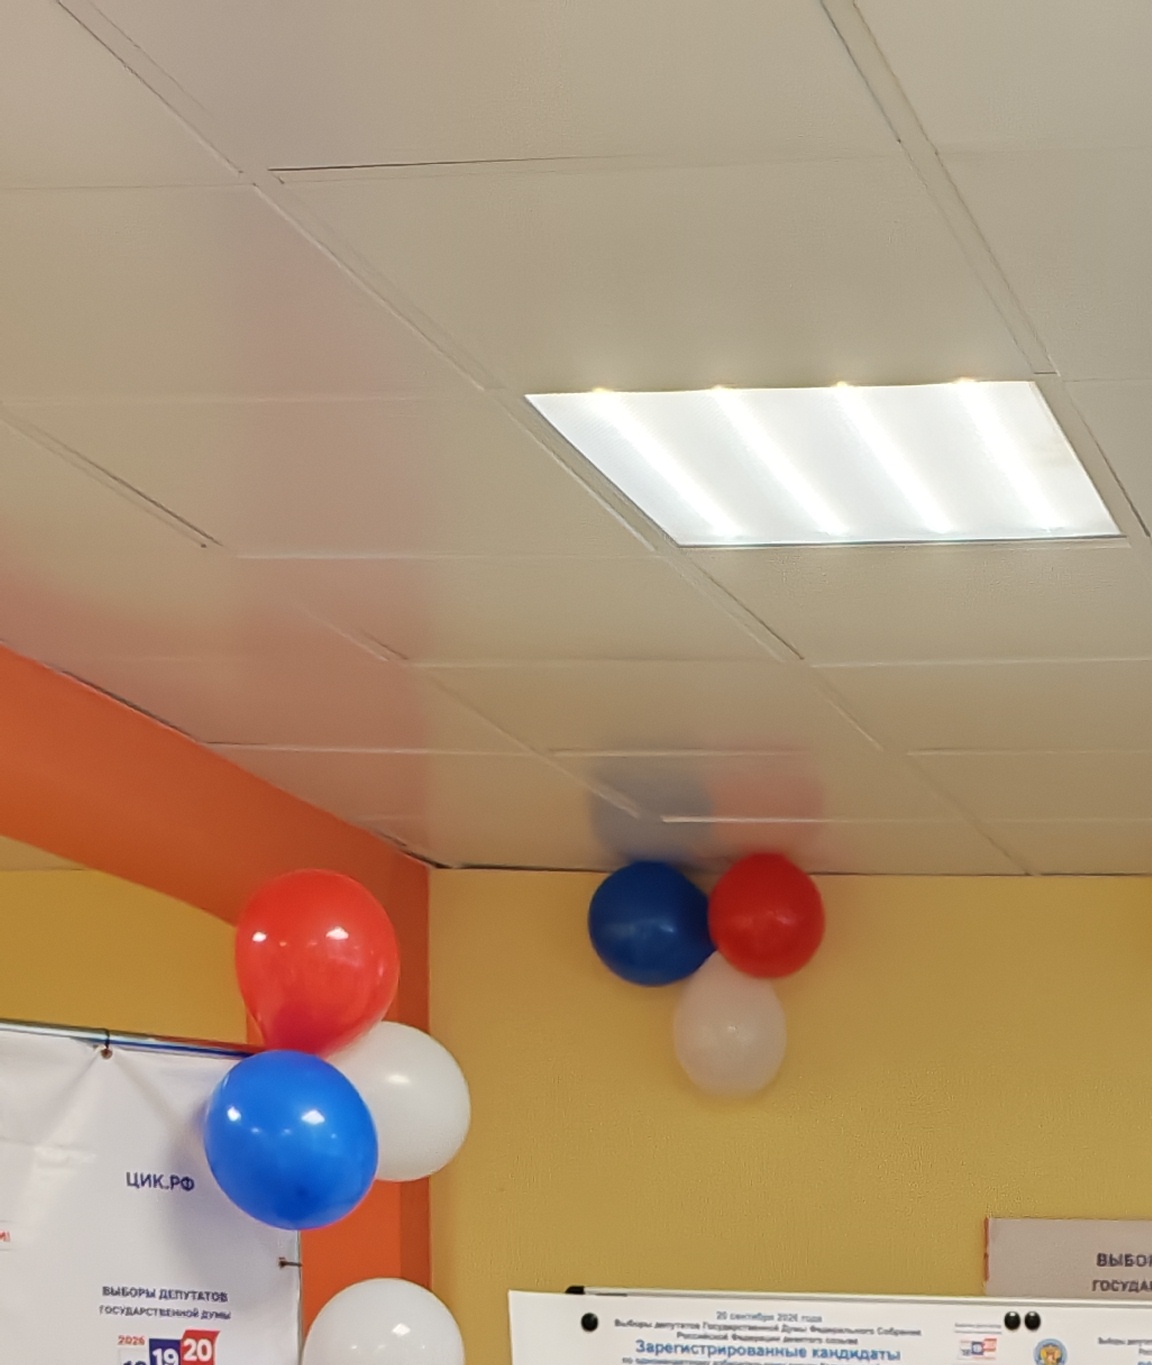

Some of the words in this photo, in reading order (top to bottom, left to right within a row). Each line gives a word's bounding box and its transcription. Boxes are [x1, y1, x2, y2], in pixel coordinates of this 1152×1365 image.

[126, 1171, 196, 1192] ЦИК.РФ
[102, 1286, 157, 1299] ВЫБОРЫ
[158, 1289, 229, 1302] ДЕПУТАТОВ
[99, 1304, 199, 1320] ГОСУДАРСТВЕННОЙ
[117, 1335, 146, 1346] 2026
[182, 1338, 212, 1362] 20
[635, 1339, 807, 1358] Зарегистрированные
[812, 1347, 901, 1361] кандидаты
